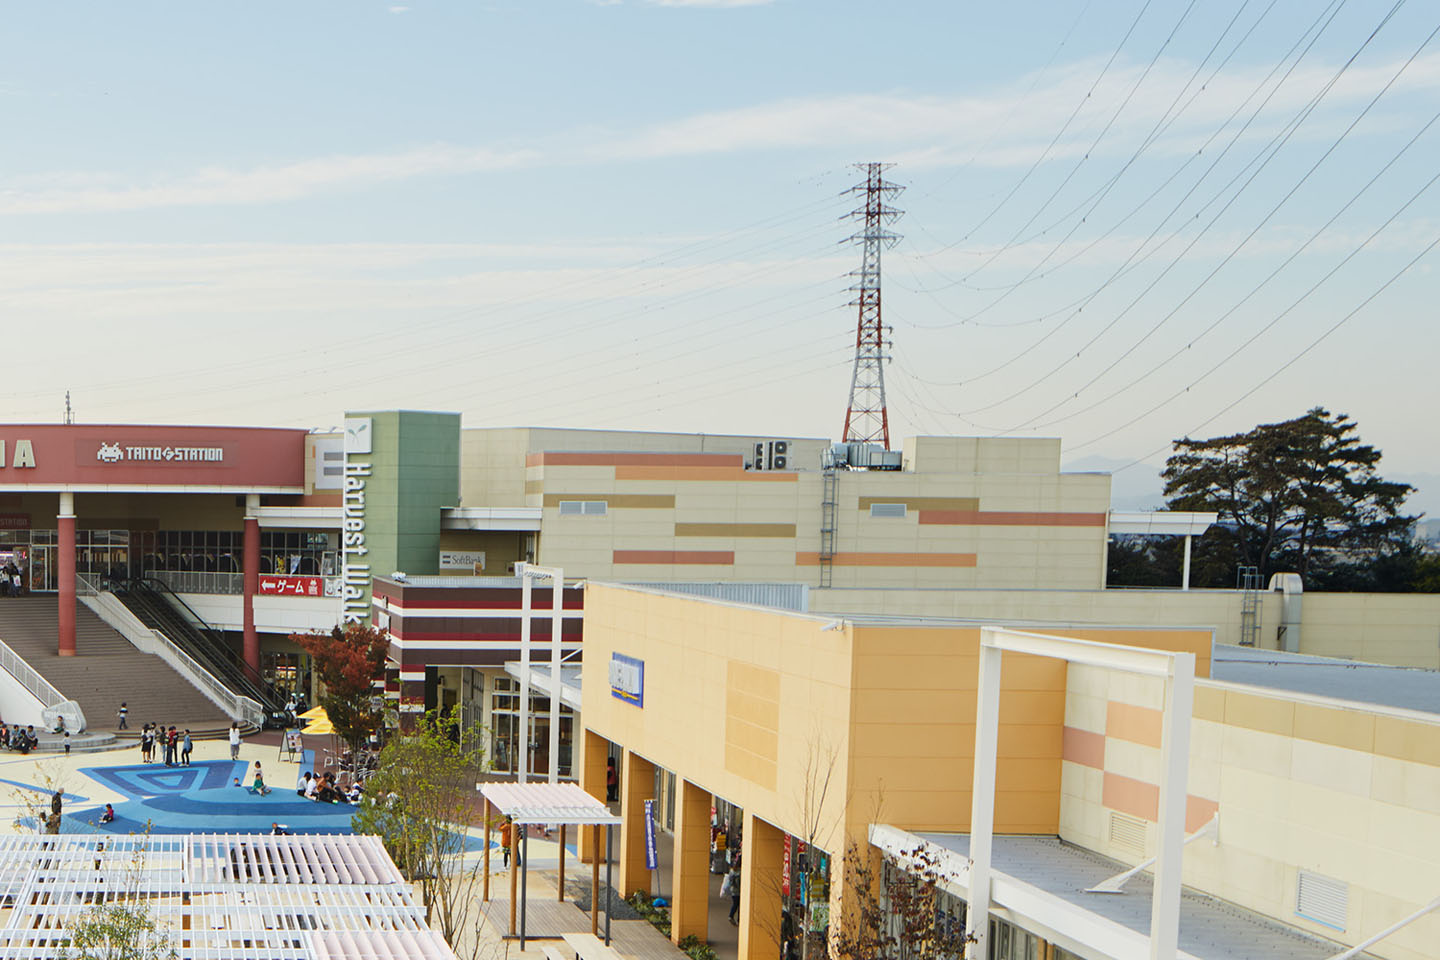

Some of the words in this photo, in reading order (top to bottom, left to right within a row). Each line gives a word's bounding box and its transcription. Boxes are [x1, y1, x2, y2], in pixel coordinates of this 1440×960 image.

[125, 446, 161, 461] TAITO
[175, 447, 223, 462] STATION
[345, 462, 373, 556] Harvest
[277, 579, 304, 593] ゲーム
[344, 564, 371, 625] Walk
